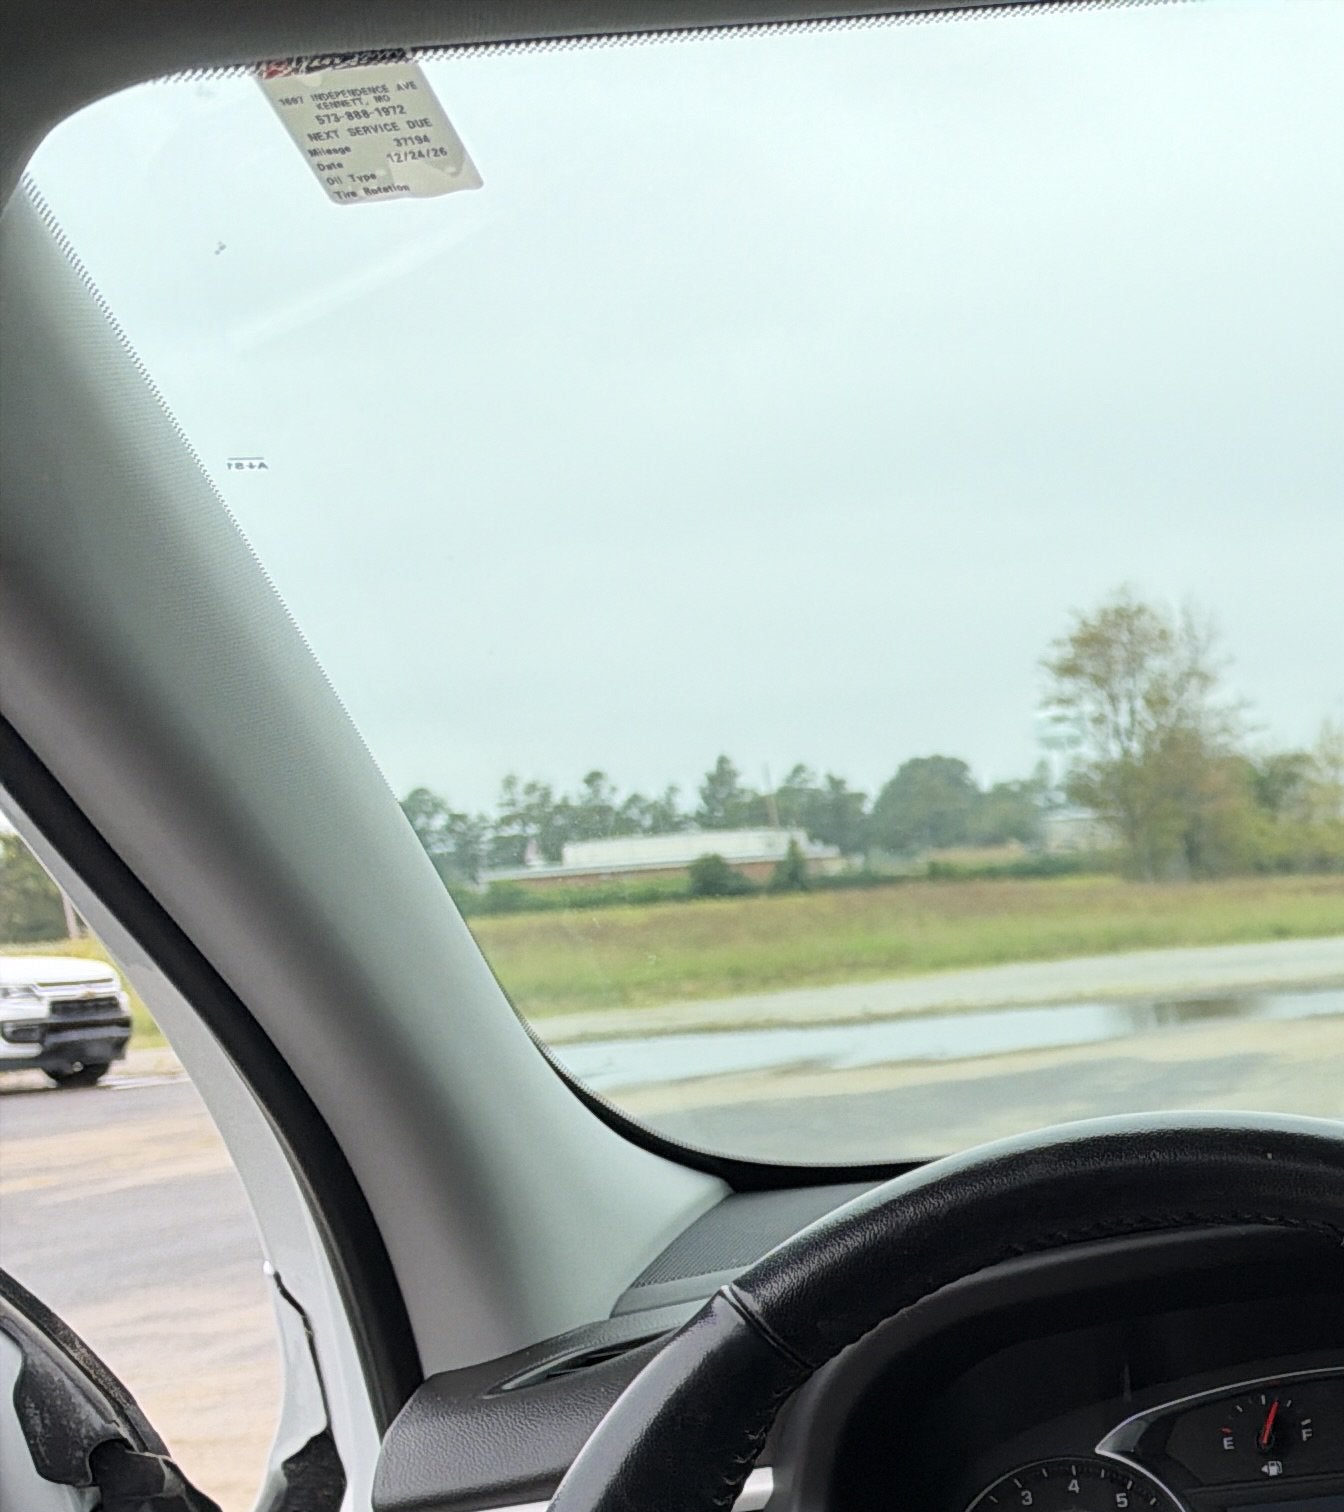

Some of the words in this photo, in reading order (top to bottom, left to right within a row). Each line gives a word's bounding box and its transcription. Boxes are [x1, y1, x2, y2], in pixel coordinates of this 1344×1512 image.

[310, 84, 390, 101] INDEPENDENCE
[396, 81, 418, 91] AVE
[373, 94, 391, 103] MO
[307, 129, 340, 142] NEXT
[347, 122, 401, 137] SERVICE
[406, 118, 433, 130] DUE
[307, 146, 352, 158] Mileage
[393, 134, 431, 147] 37194
[317, 162, 344, 172] Date
[386, 147, 448, 163] 12/24/26
[326, 176, 343, 186] Oil
[348, 173, 377, 184] Type
[333, 190, 358, 200] Tire
[363, 184, 411, 196] Rotation
[1302, 1428, 1312, 1442] F
[1222, 1437, 1235, 1451] E
[1068, 1479, 1080, 1494] 4
[1021, 1491, 1033, 1506] 3
[1116, 1493, 1129, 1508] 5
